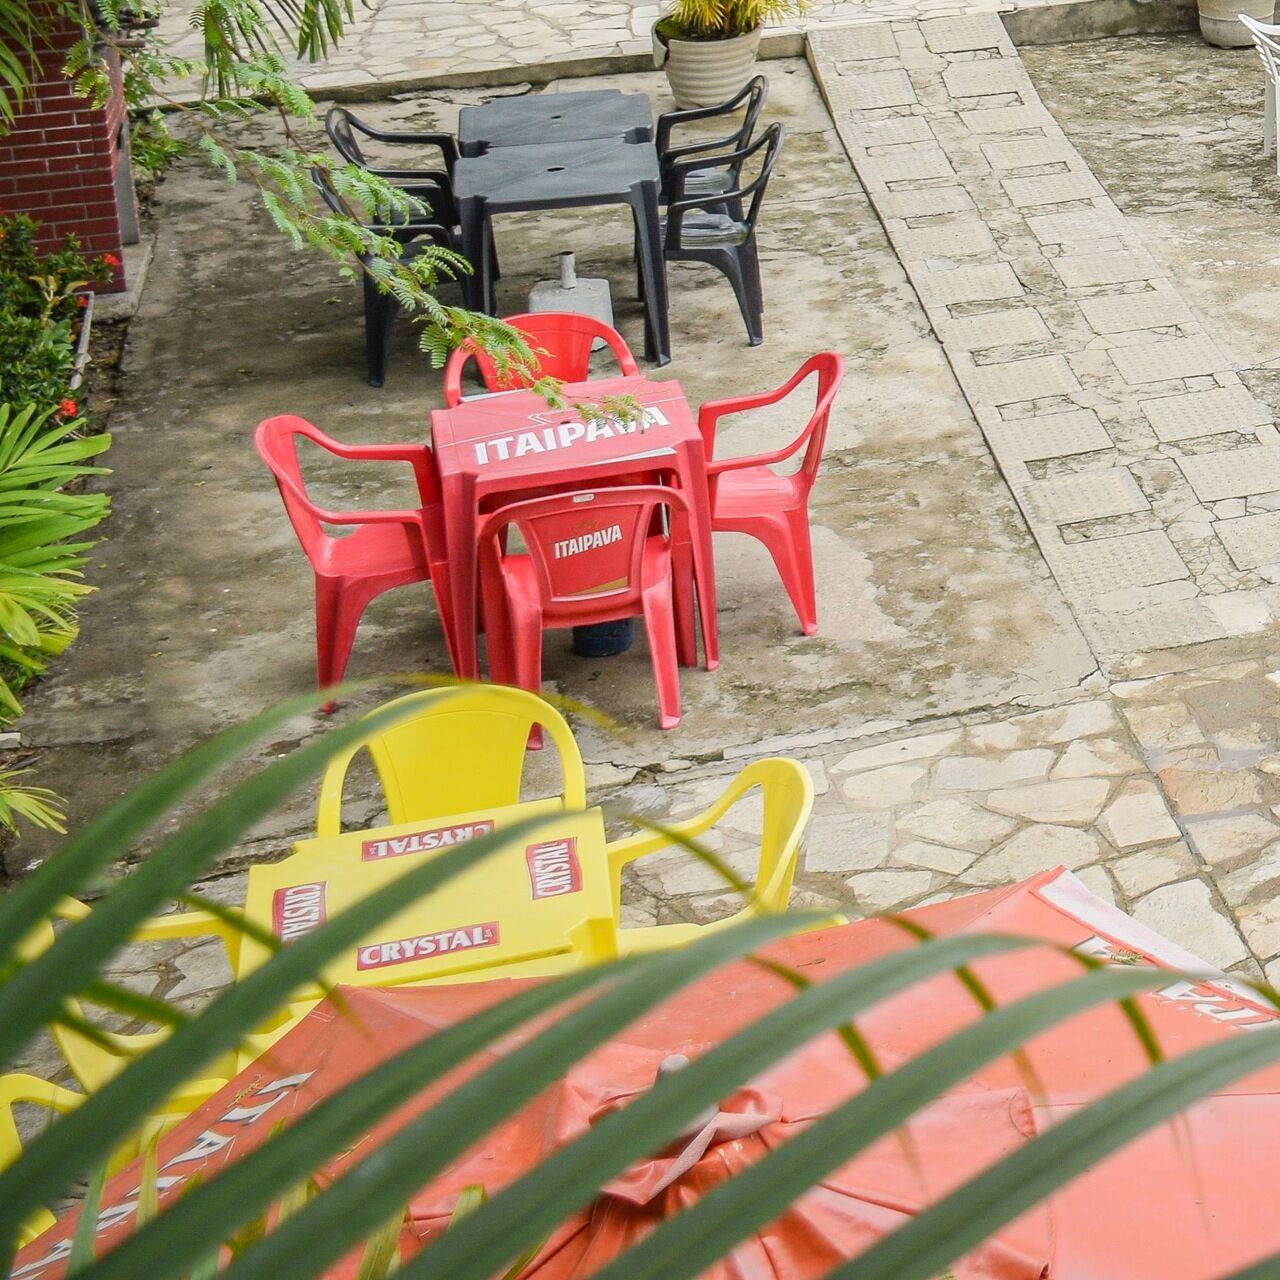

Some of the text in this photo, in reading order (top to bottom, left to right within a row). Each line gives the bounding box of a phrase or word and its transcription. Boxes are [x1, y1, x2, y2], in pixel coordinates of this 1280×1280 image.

[554, 524, 623, 559] ITAIPAVA
[534, 842, 572, 897] CRYSTAL
[360, 927, 489, 965] CRYSTAL
